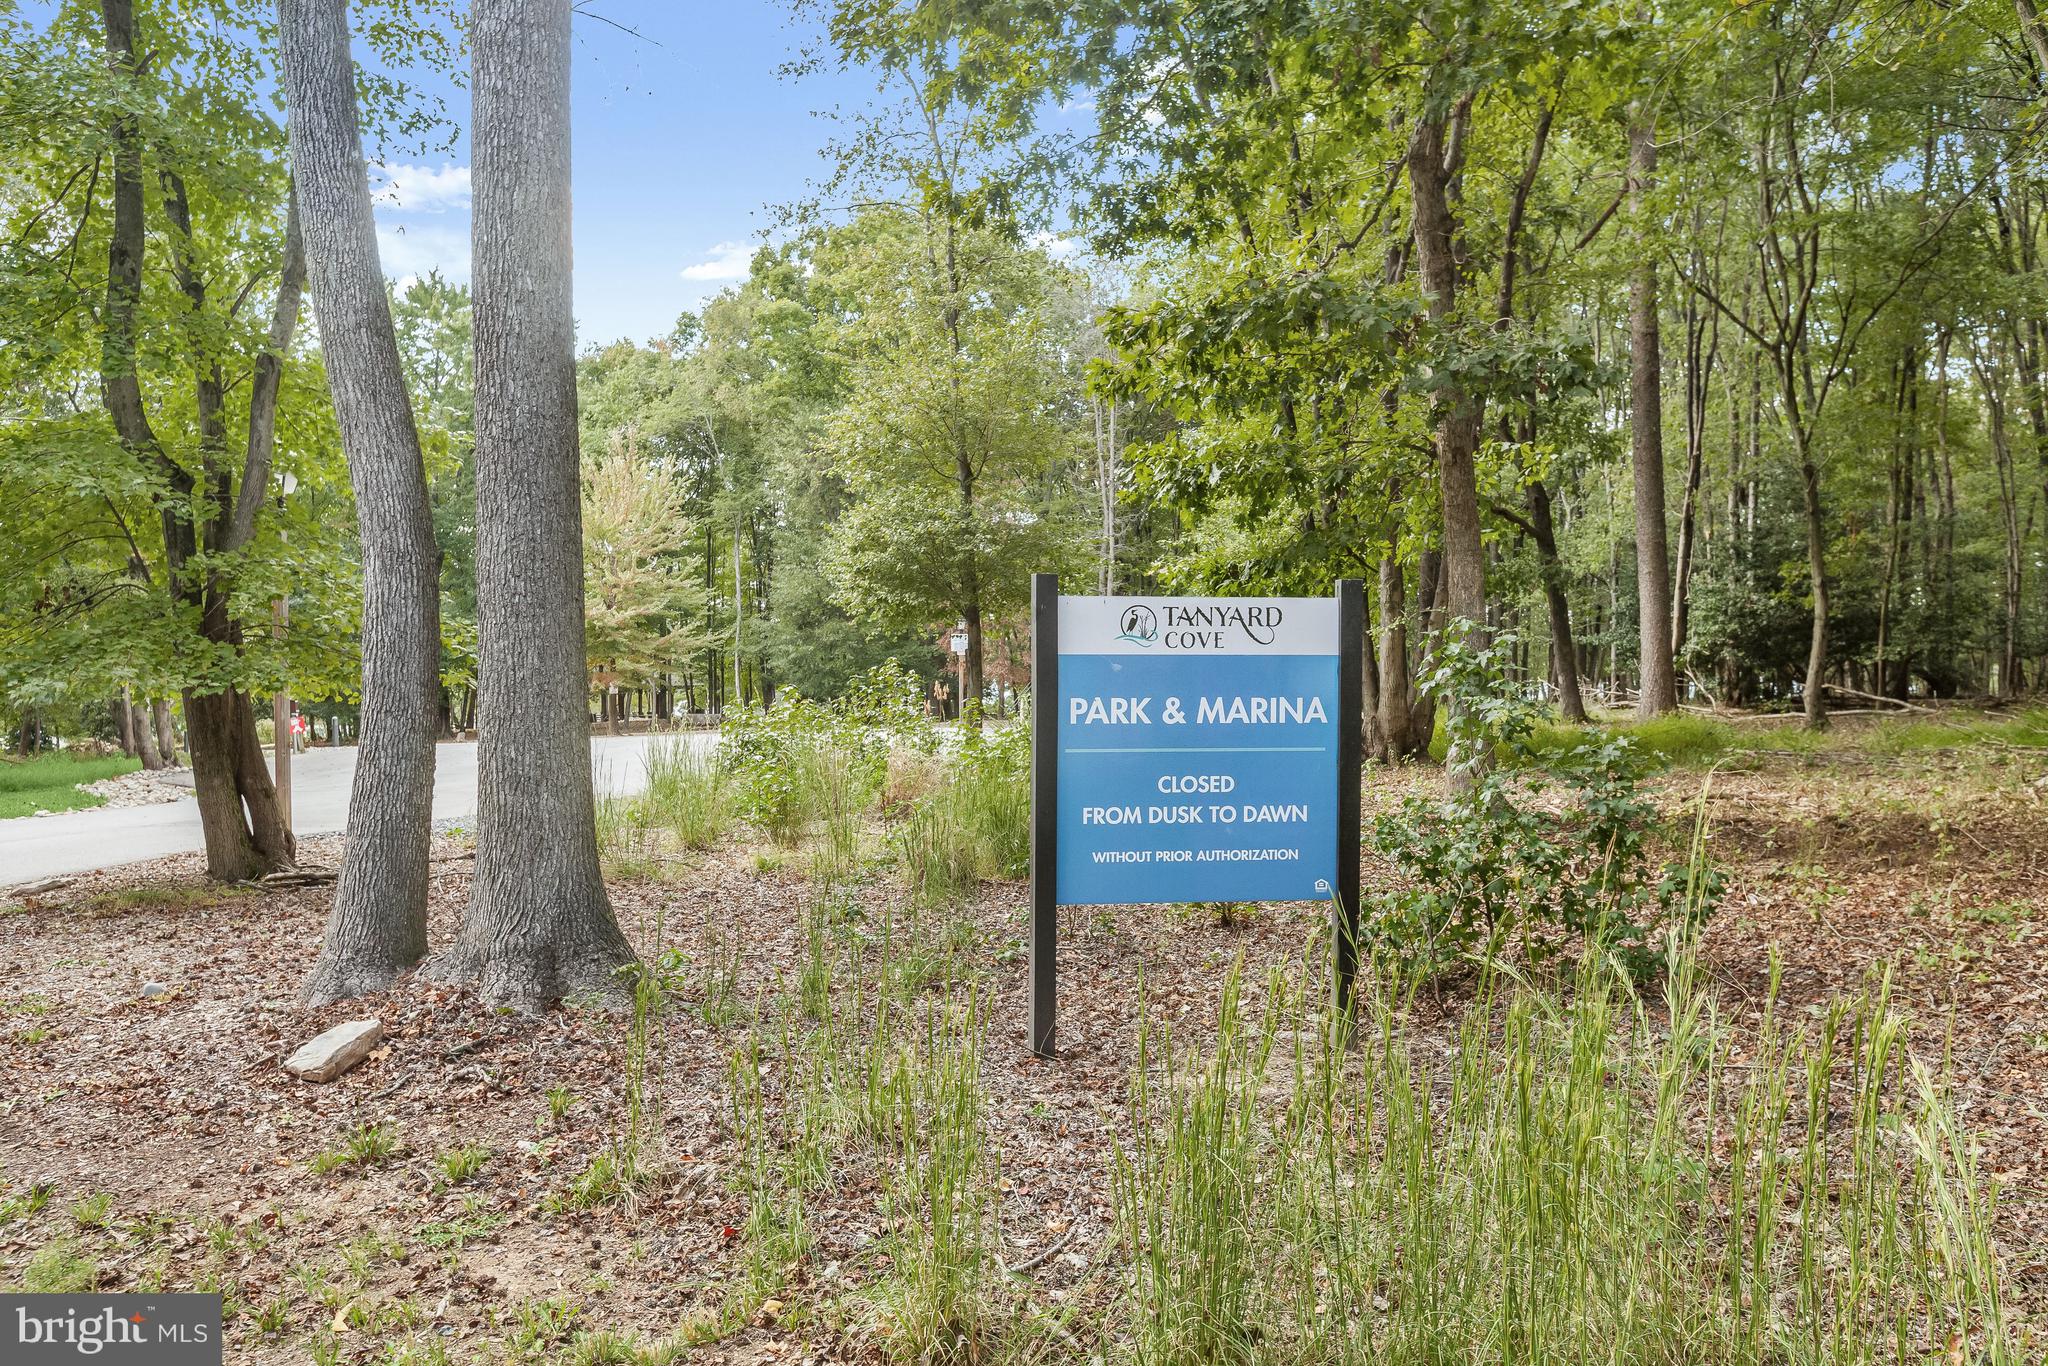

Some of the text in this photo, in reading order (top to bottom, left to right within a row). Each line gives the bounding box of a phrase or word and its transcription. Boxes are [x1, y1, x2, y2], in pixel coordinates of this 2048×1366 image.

[1163, 606, 1283, 645] TANYARD
[1165, 631, 1225, 649] COVE
[1069, 696, 1328, 725] PARK & MARINA
[1157, 775, 1235, 794] CLOSED
[1082, 804, 1308, 825] FROM DUSK TO DAWN
[1092, 848, 1299, 864] WITHOUT PRIOR AUTHORIZATION
